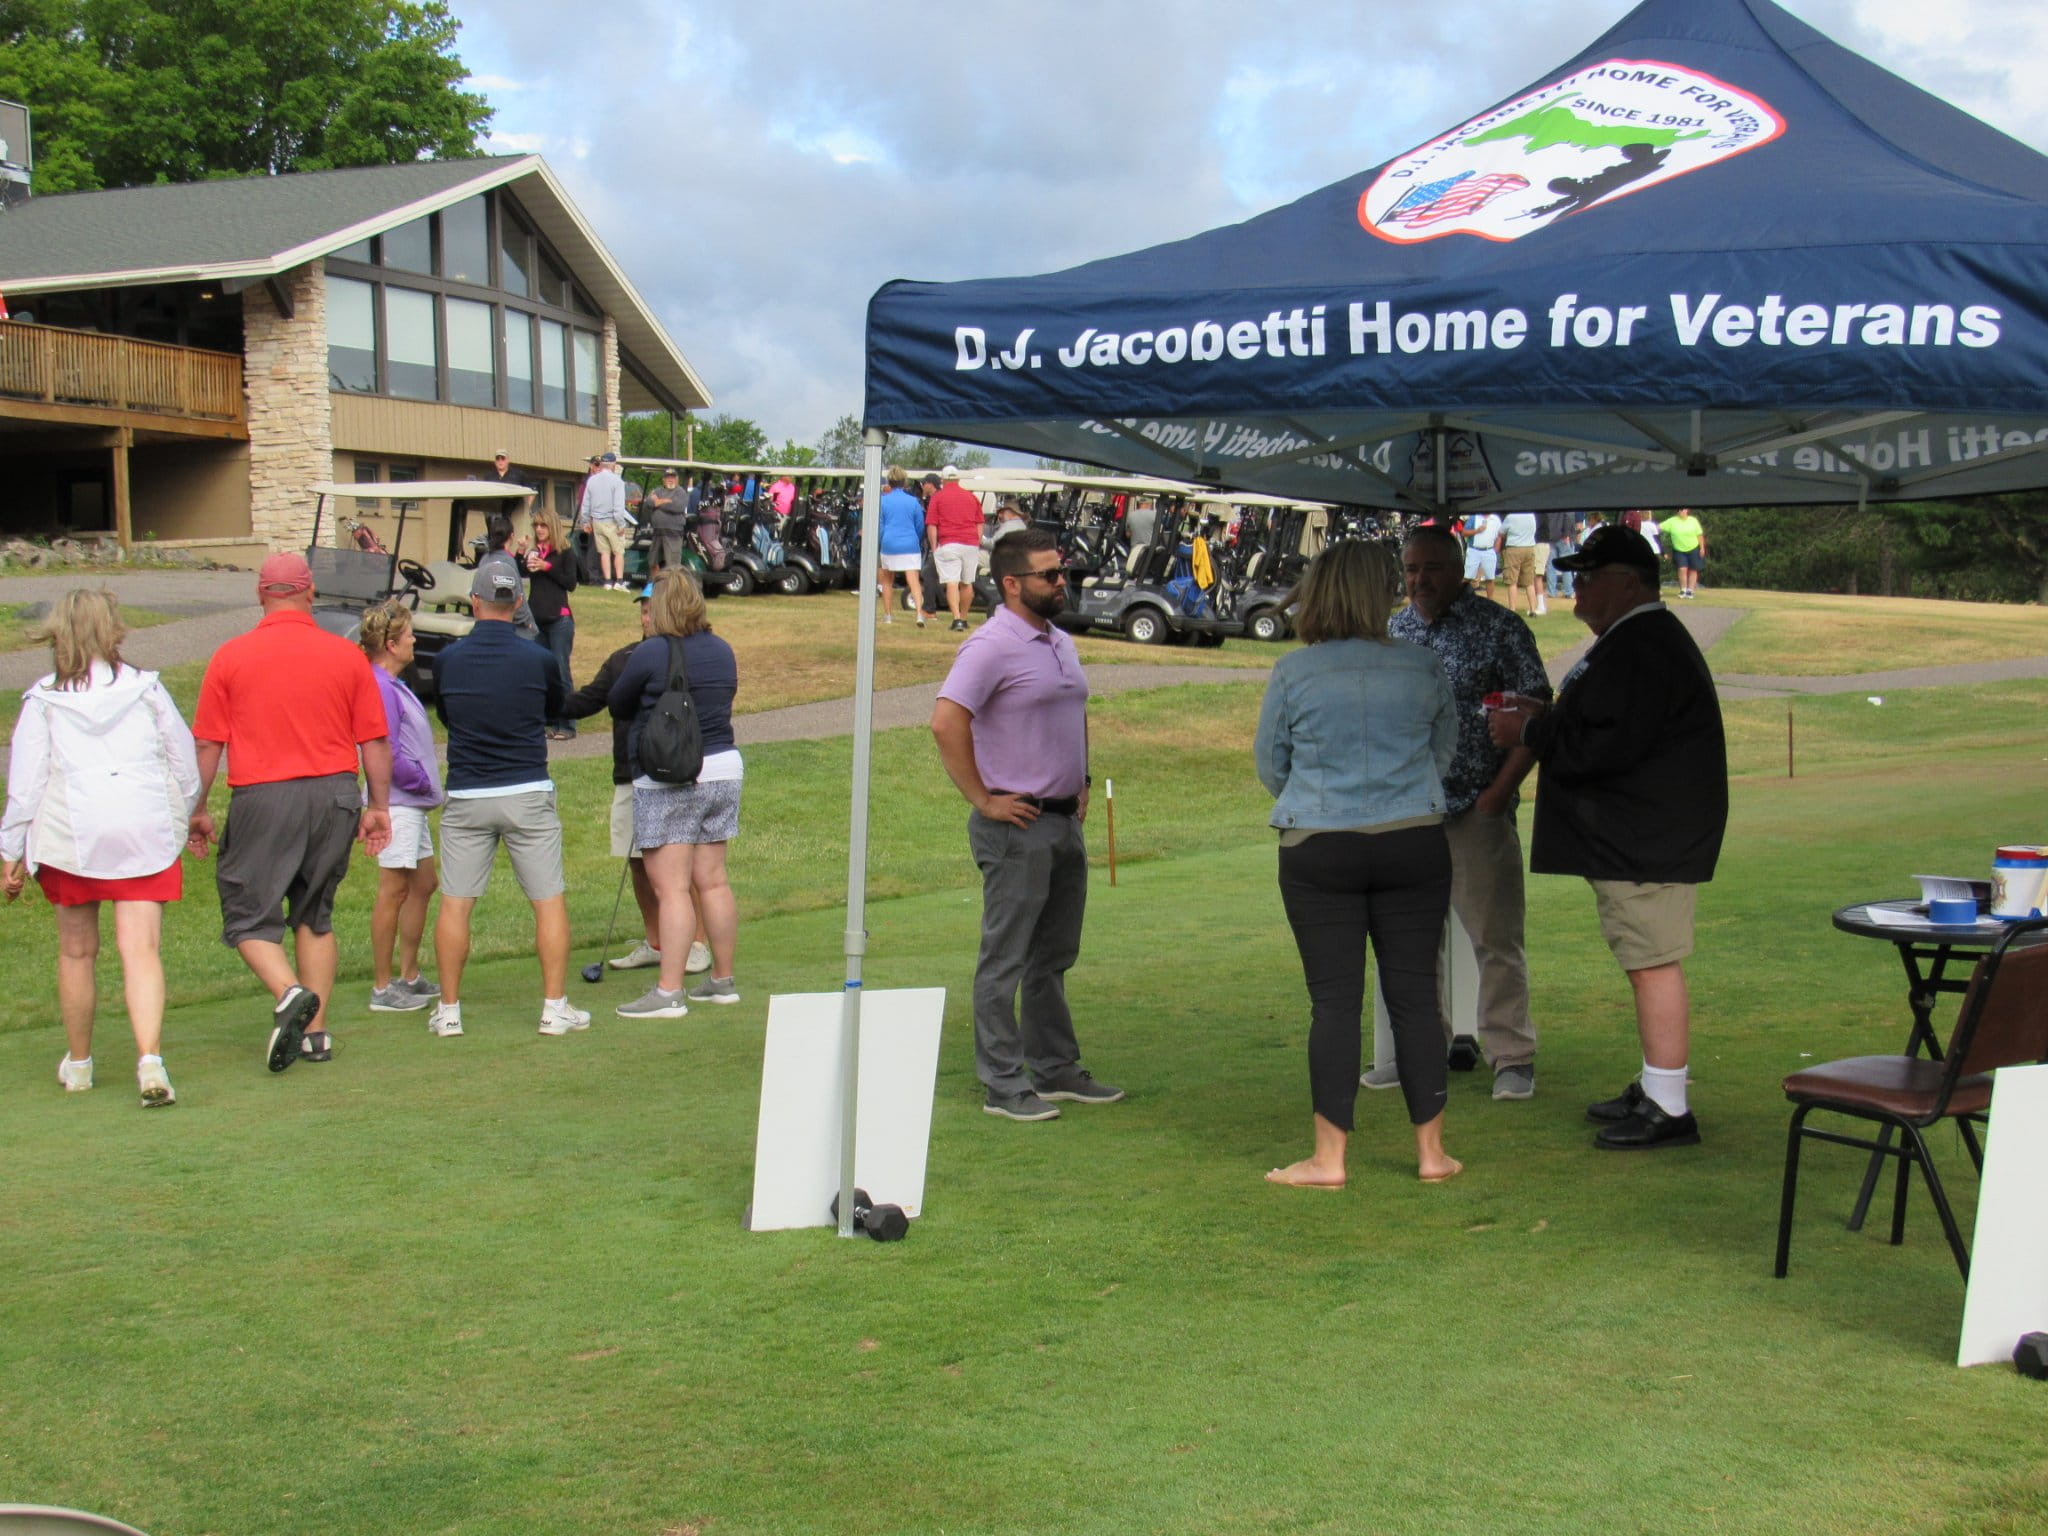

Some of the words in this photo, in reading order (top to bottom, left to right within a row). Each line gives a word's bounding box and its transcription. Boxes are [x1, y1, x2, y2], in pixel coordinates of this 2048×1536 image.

[1588, 67, 1679, 89] HOME
[1680, 86, 1732, 112] FOR
[1571, 98, 1642, 120] SINCE
[1646, 113, 1706, 127] 1981
[954, 326, 1042, 371] D.J.
[1058, 304, 1327, 368] Jacobetti
[1348, 301, 1528, 354] Home
[1548, 293, 1648, 347] for
[1669, 293, 2002, 348] Veterans
